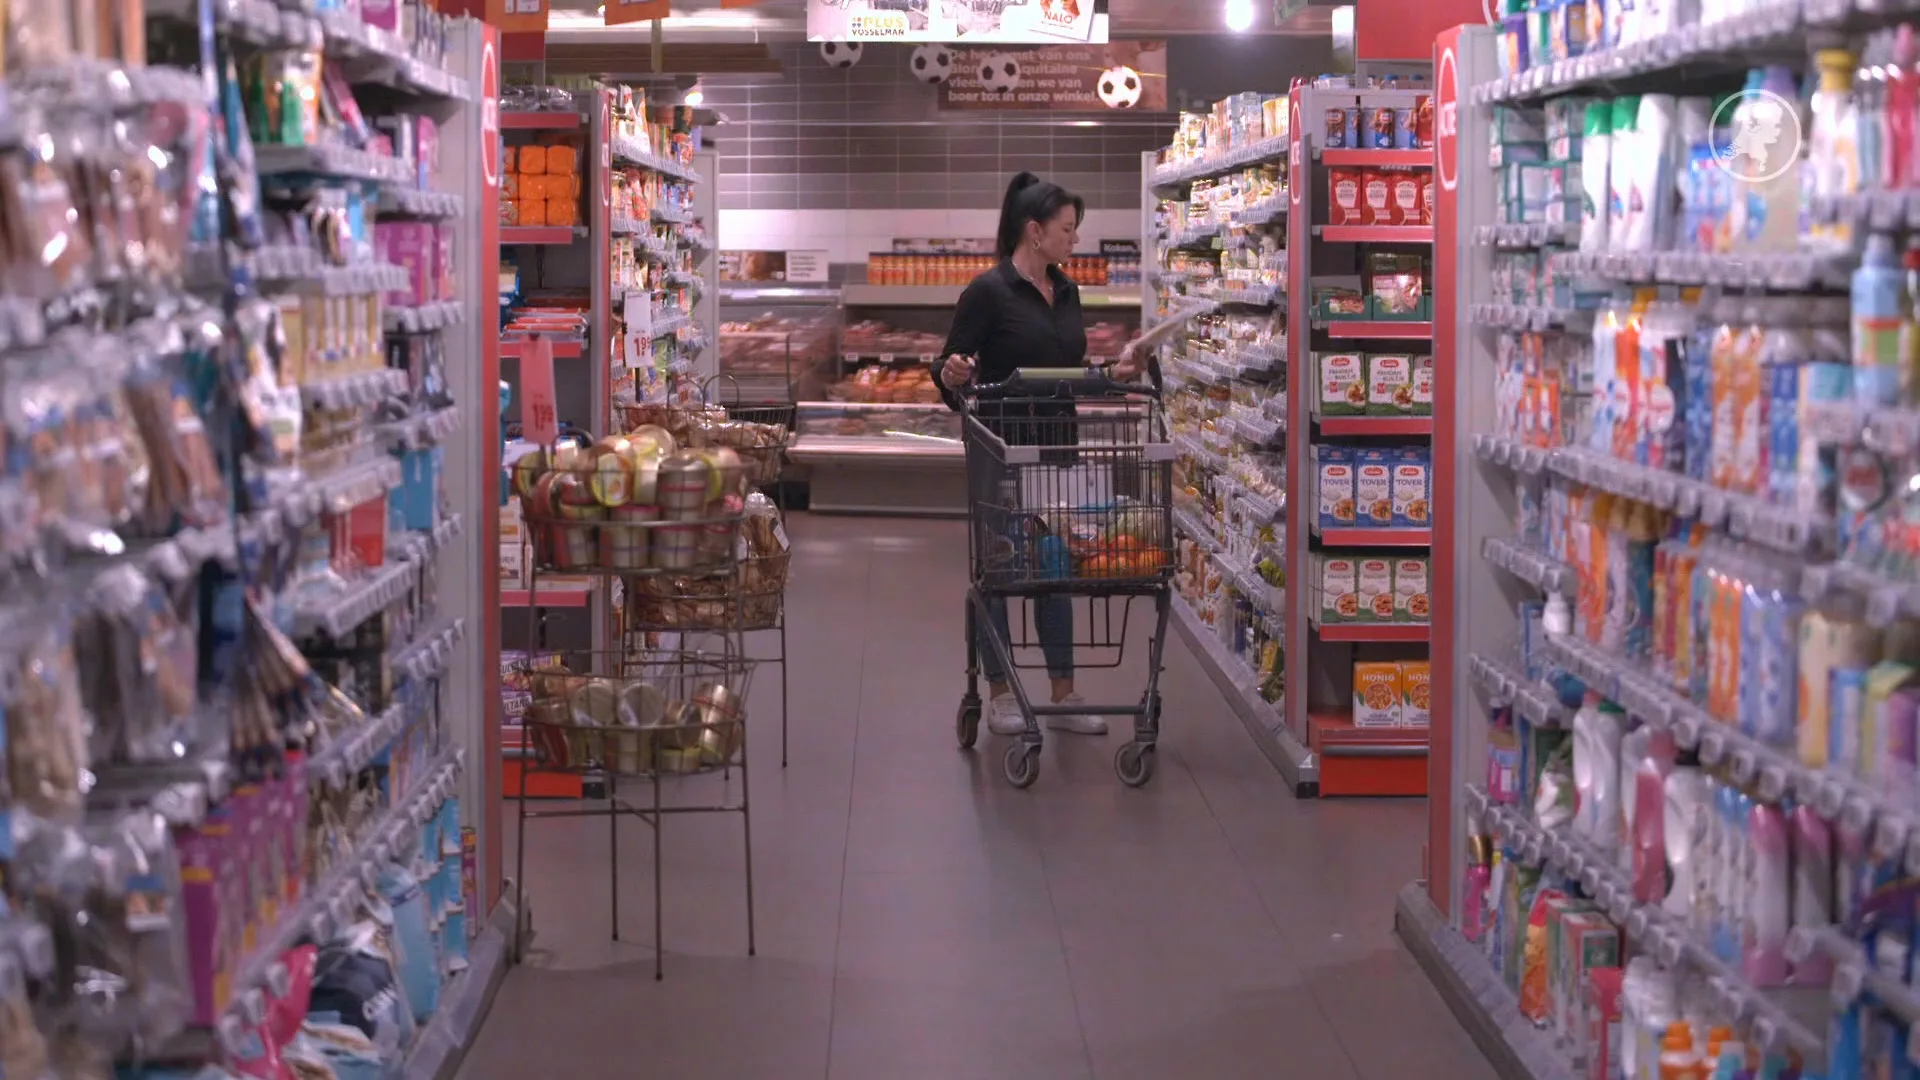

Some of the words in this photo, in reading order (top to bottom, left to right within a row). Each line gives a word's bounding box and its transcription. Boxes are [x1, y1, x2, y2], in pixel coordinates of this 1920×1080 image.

[864, 17, 904, 28] PLUS
[1038, 52, 1064, 60] van
[1066, 52, 1091, 60] ons
[1037, 80, 1056, 88] we
[1058, 80, 1082, 88] van
[948, 91, 978, 101] boer
[980, 91, 1000, 101] tot
[1002, 91, 1015, 101] in
[1018, 92, 1050, 101] onze
[1363, 673, 1395, 682] HONIG
[1408, 673, 1431, 682] HON
